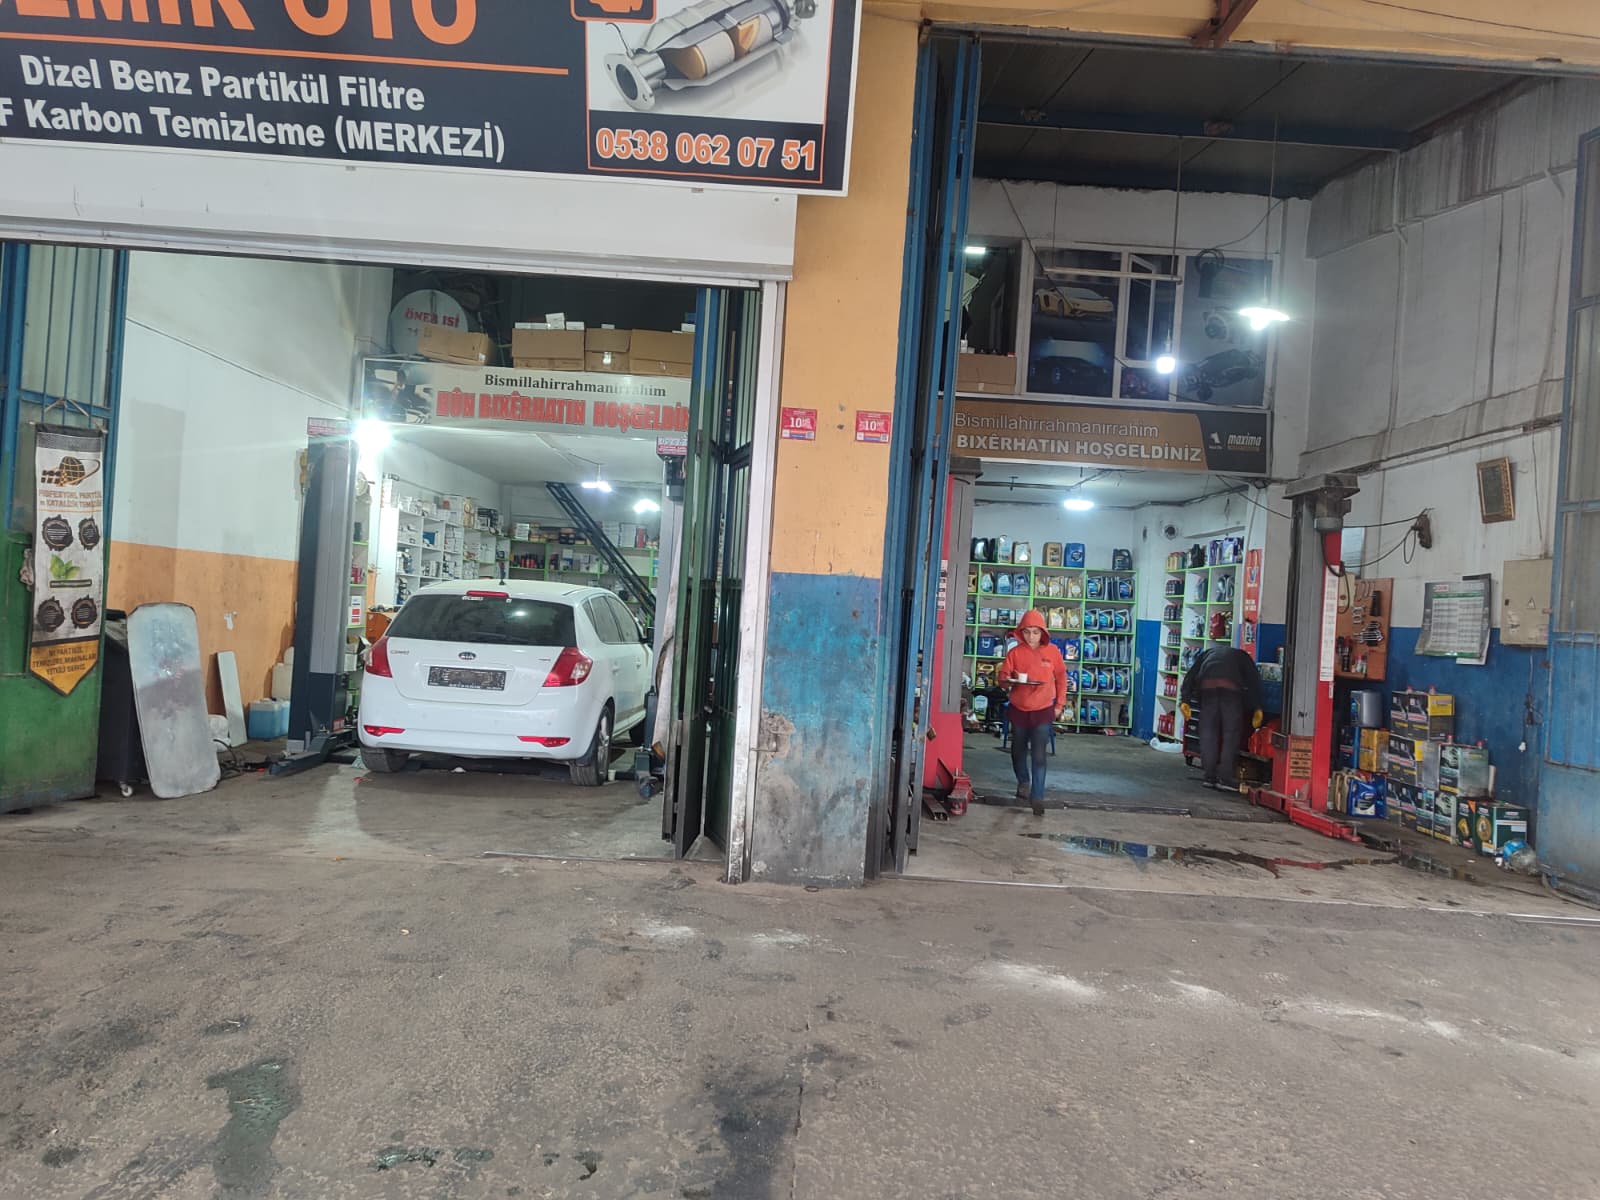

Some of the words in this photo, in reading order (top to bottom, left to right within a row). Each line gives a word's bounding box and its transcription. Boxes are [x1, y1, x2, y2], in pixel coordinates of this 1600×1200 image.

[20, 54, 102, 88] Dizel
[109, 59, 193, 95] Benz
[200, 66, 329, 105] Partikül
[338, 75, 425, 111] Filtre
[24, 98, 142, 135] Karbon
[149, 106, 326, 147] Temizleme
[335, 115, 505, 163] (MERKEZİ)
[596, 127, 669, 161] 0538
[676, 132, 731, 165] 062
[737, 136, 775, 168] 07
[781, 139, 816, 171] 51
[1075, 440, 1202, 463] HOŞGELDİNİZ
